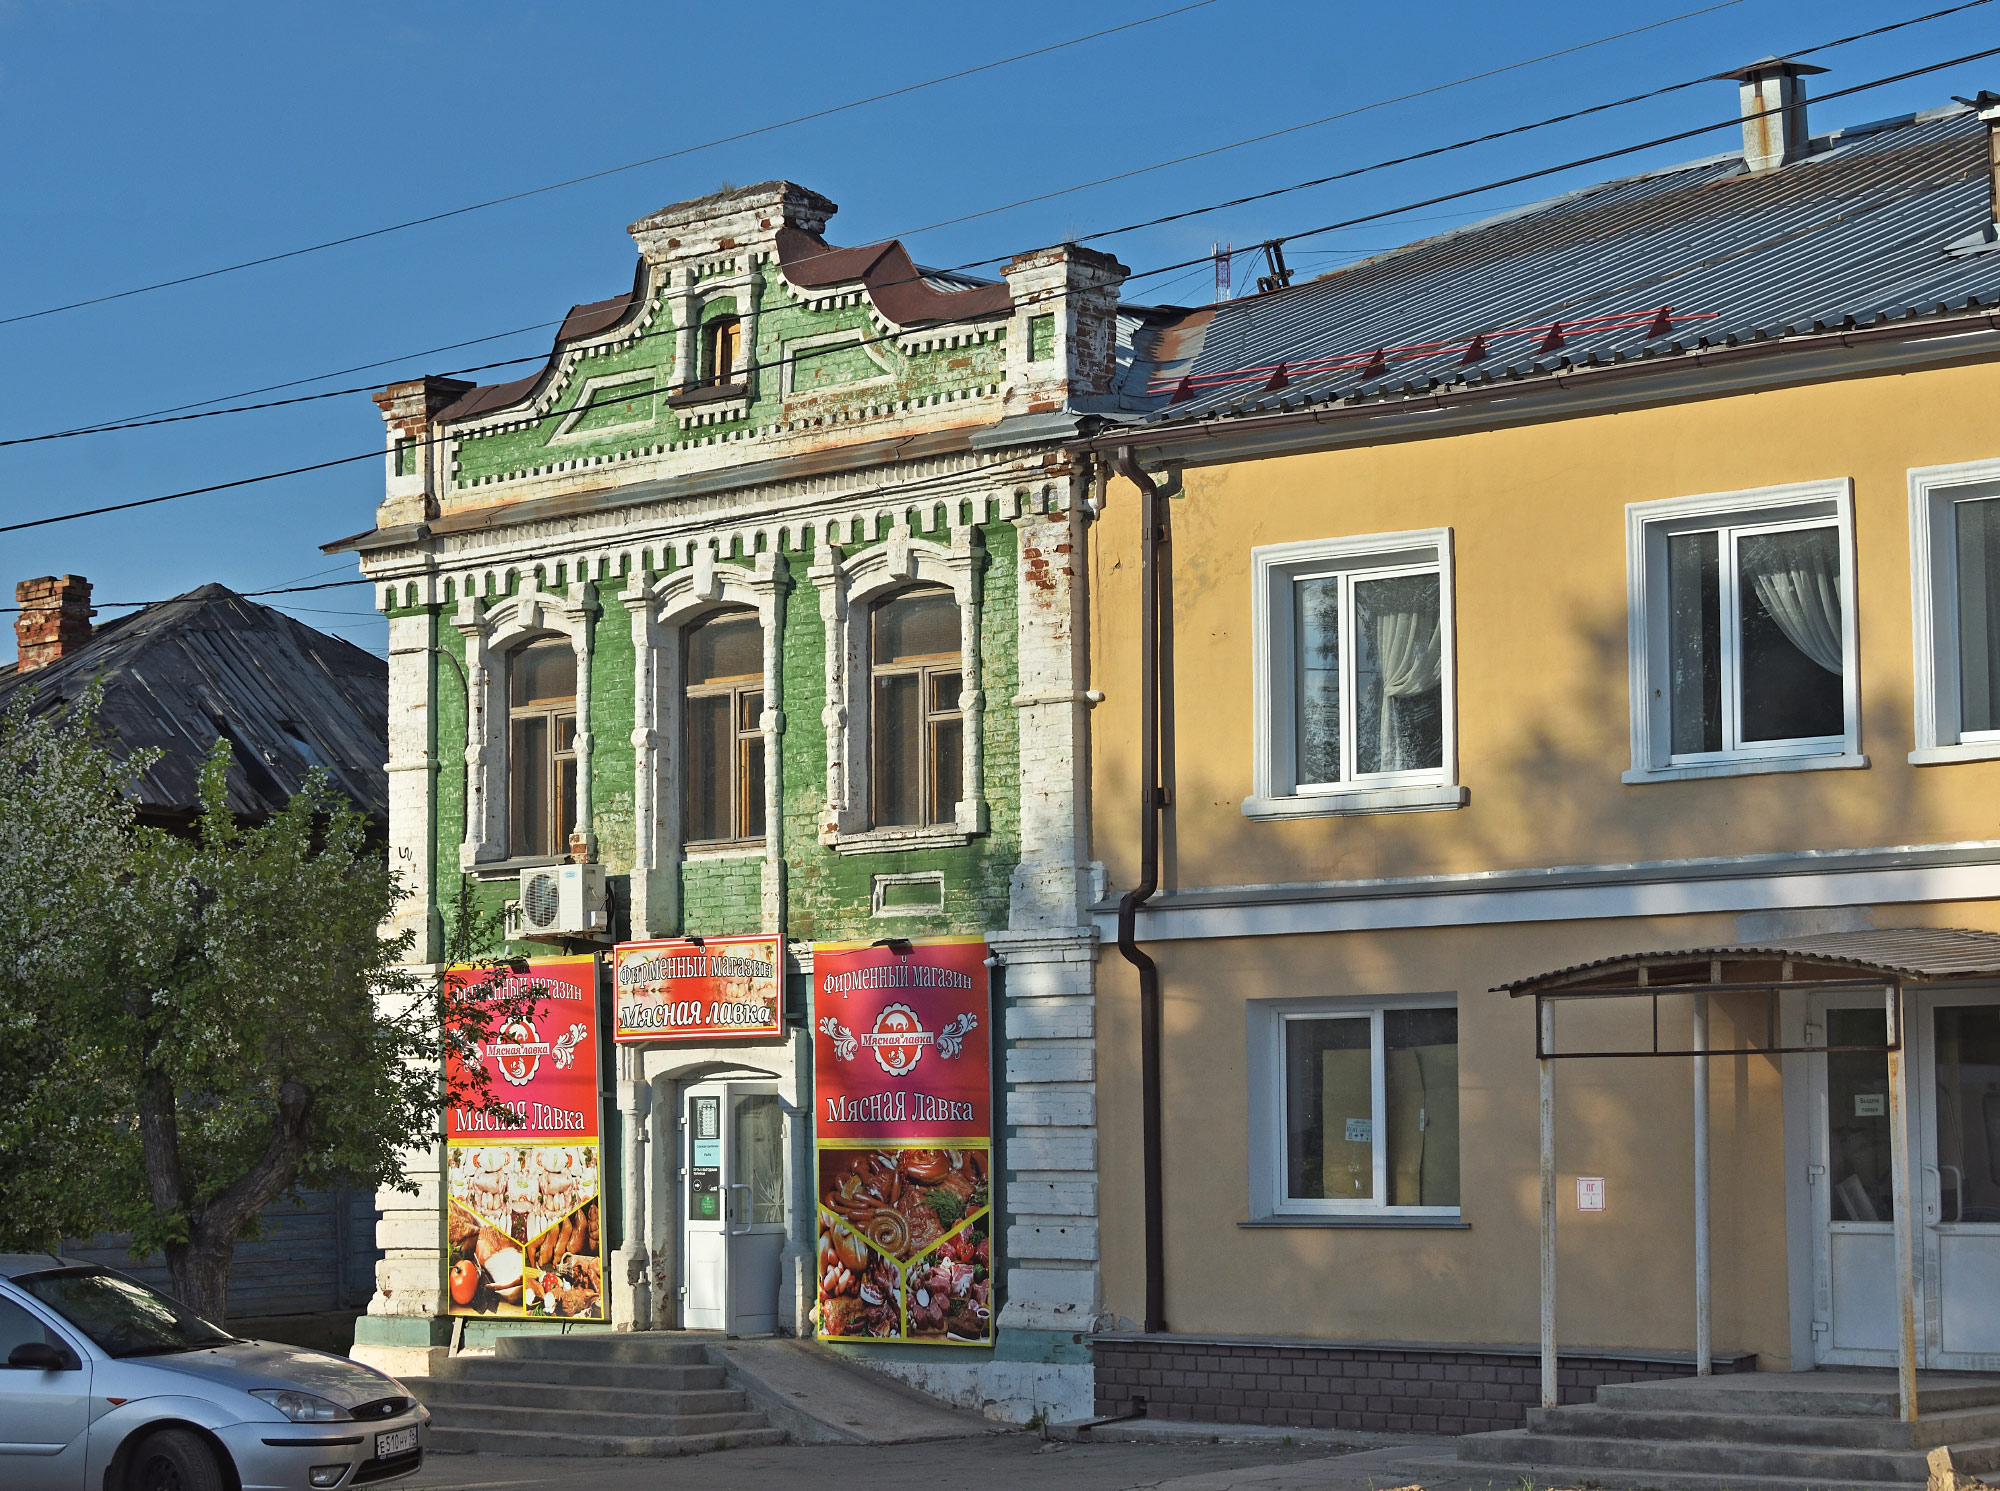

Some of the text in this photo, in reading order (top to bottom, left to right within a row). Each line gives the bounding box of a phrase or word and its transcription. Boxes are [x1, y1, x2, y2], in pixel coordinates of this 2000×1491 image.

[619, 946, 773, 989] Фирменный магазин
[823, 955, 972, 999] Фирменный магазин
[619, 1001, 771, 1028] Мясная лавка
[487, 1044, 549, 1056] Мясная лавка
[862, 1034, 932, 1045] Мясная лавка
[531, 1101, 585, 1131] лавка
[826, 1091, 974, 1122] Мясная лавка
